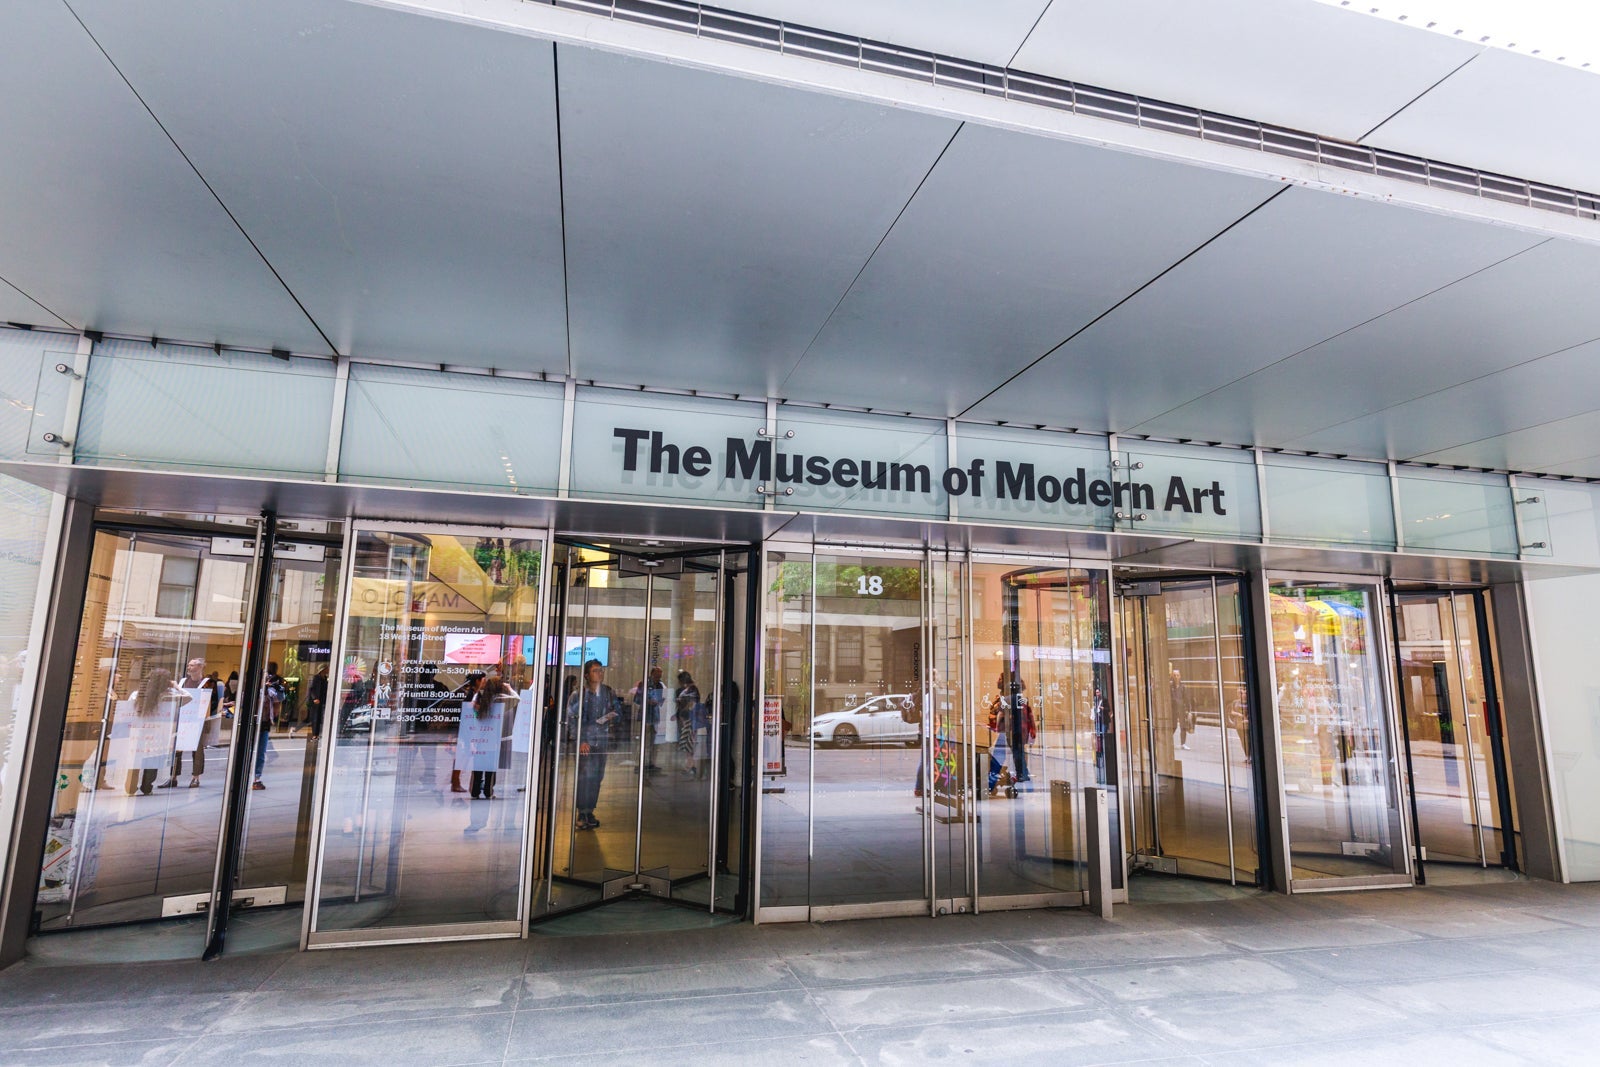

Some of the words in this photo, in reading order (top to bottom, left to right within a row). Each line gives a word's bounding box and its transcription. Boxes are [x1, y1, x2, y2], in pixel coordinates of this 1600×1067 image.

[613, 427, 711, 478] The
[724, 437, 931, 494] Museum
[942, 459, 985, 497] of
[995, 460, 1155, 510] Modern
[1164, 475, 1227, 517] Art
[857, 575, 883, 595] 18
[380, 624, 395, 632] The
[396, 624, 429, 632] Museum
[440, 625, 470, 633] Modern
